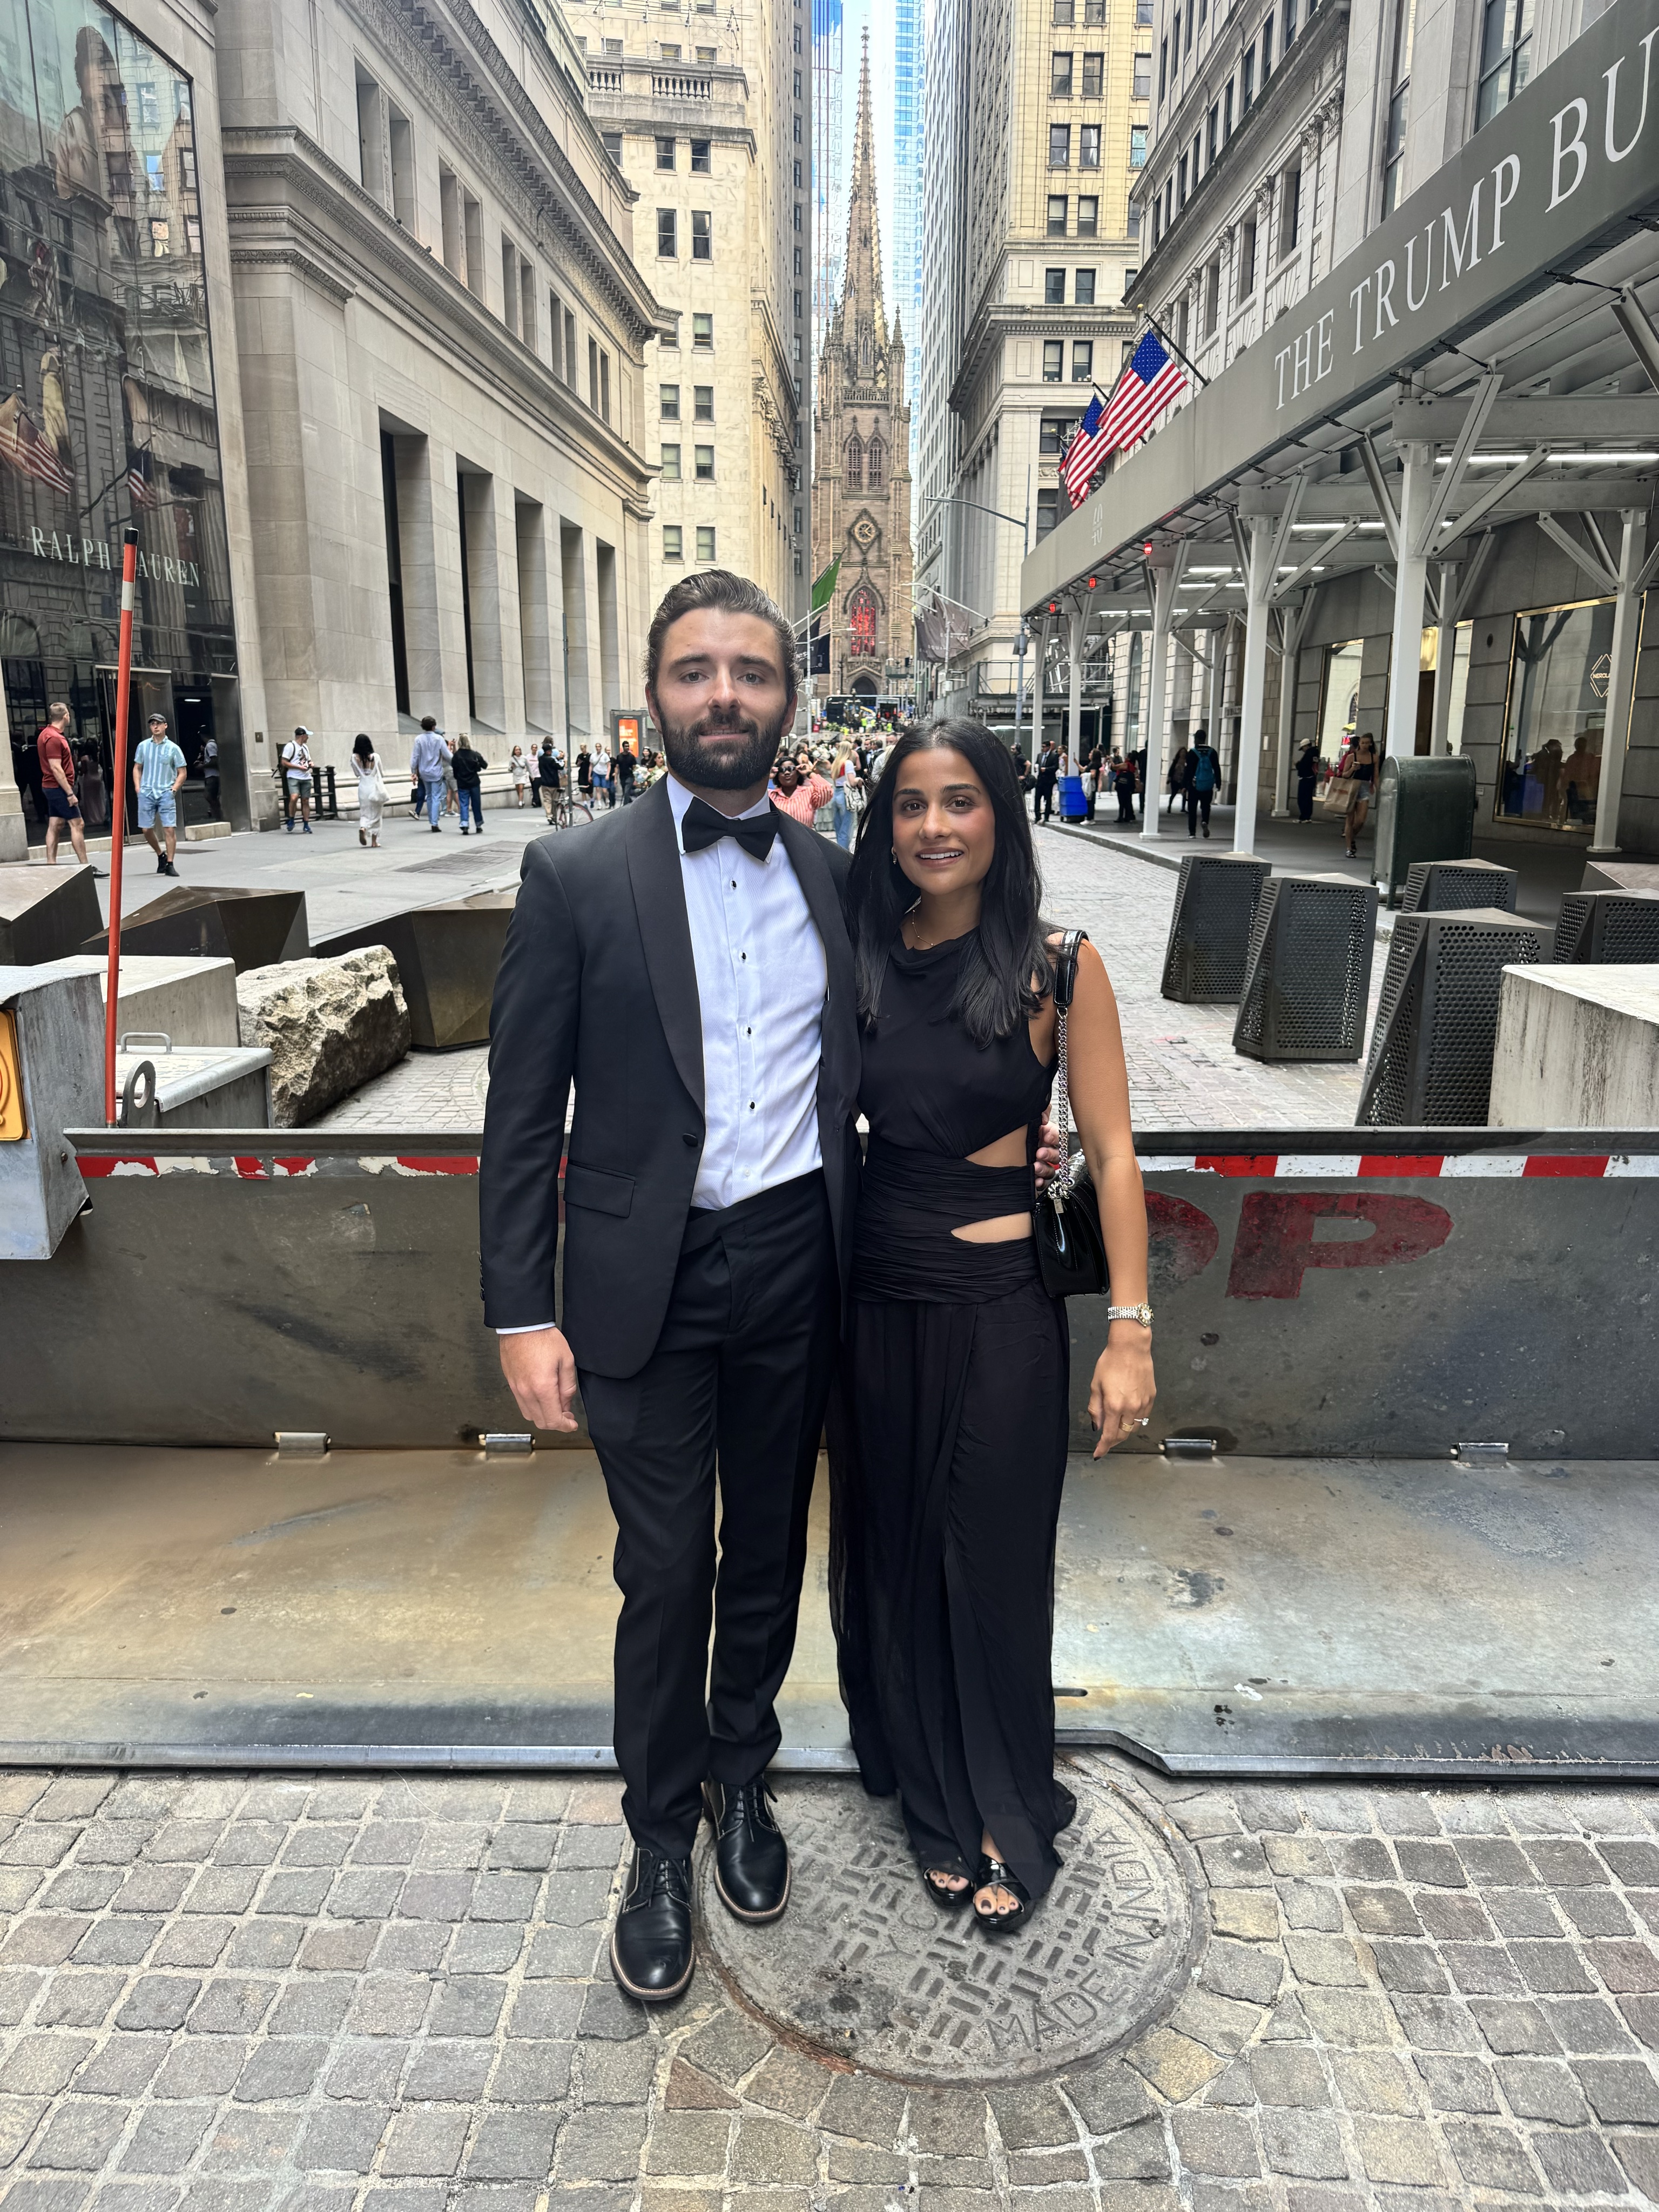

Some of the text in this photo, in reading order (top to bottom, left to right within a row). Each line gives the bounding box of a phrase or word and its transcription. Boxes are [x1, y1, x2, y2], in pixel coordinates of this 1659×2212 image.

[1273, 26, 1659, 411] THE TRUMP BU
[31, 525, 200, 588] RALPH AUREN
[984, 1827, 1162, 2052] MADE IN INDIA
